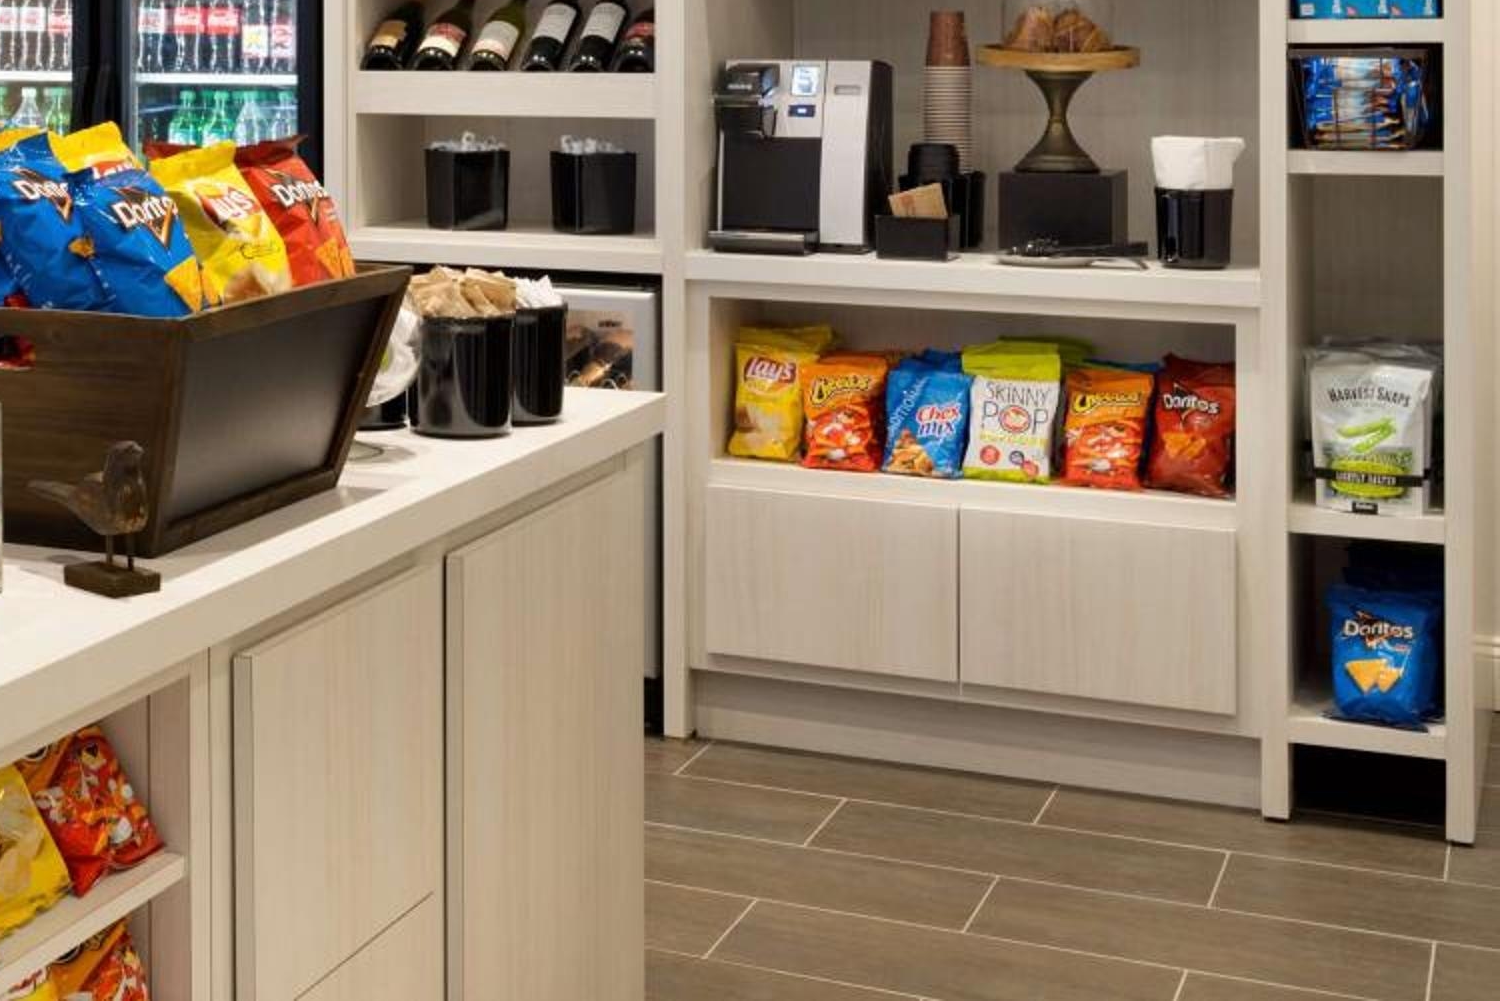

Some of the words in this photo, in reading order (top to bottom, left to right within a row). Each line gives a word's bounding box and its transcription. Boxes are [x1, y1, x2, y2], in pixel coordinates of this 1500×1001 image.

[745, 357, 796, 383] Lay's
[985, 381, 1052, 407] SKINNY
[1162, 392, 1221, 416] Doritos
[917, 402, 962, 424] Chex
[981, 400, 1050, 436] POP
[1342, 618, 1413, 638] Doritos
